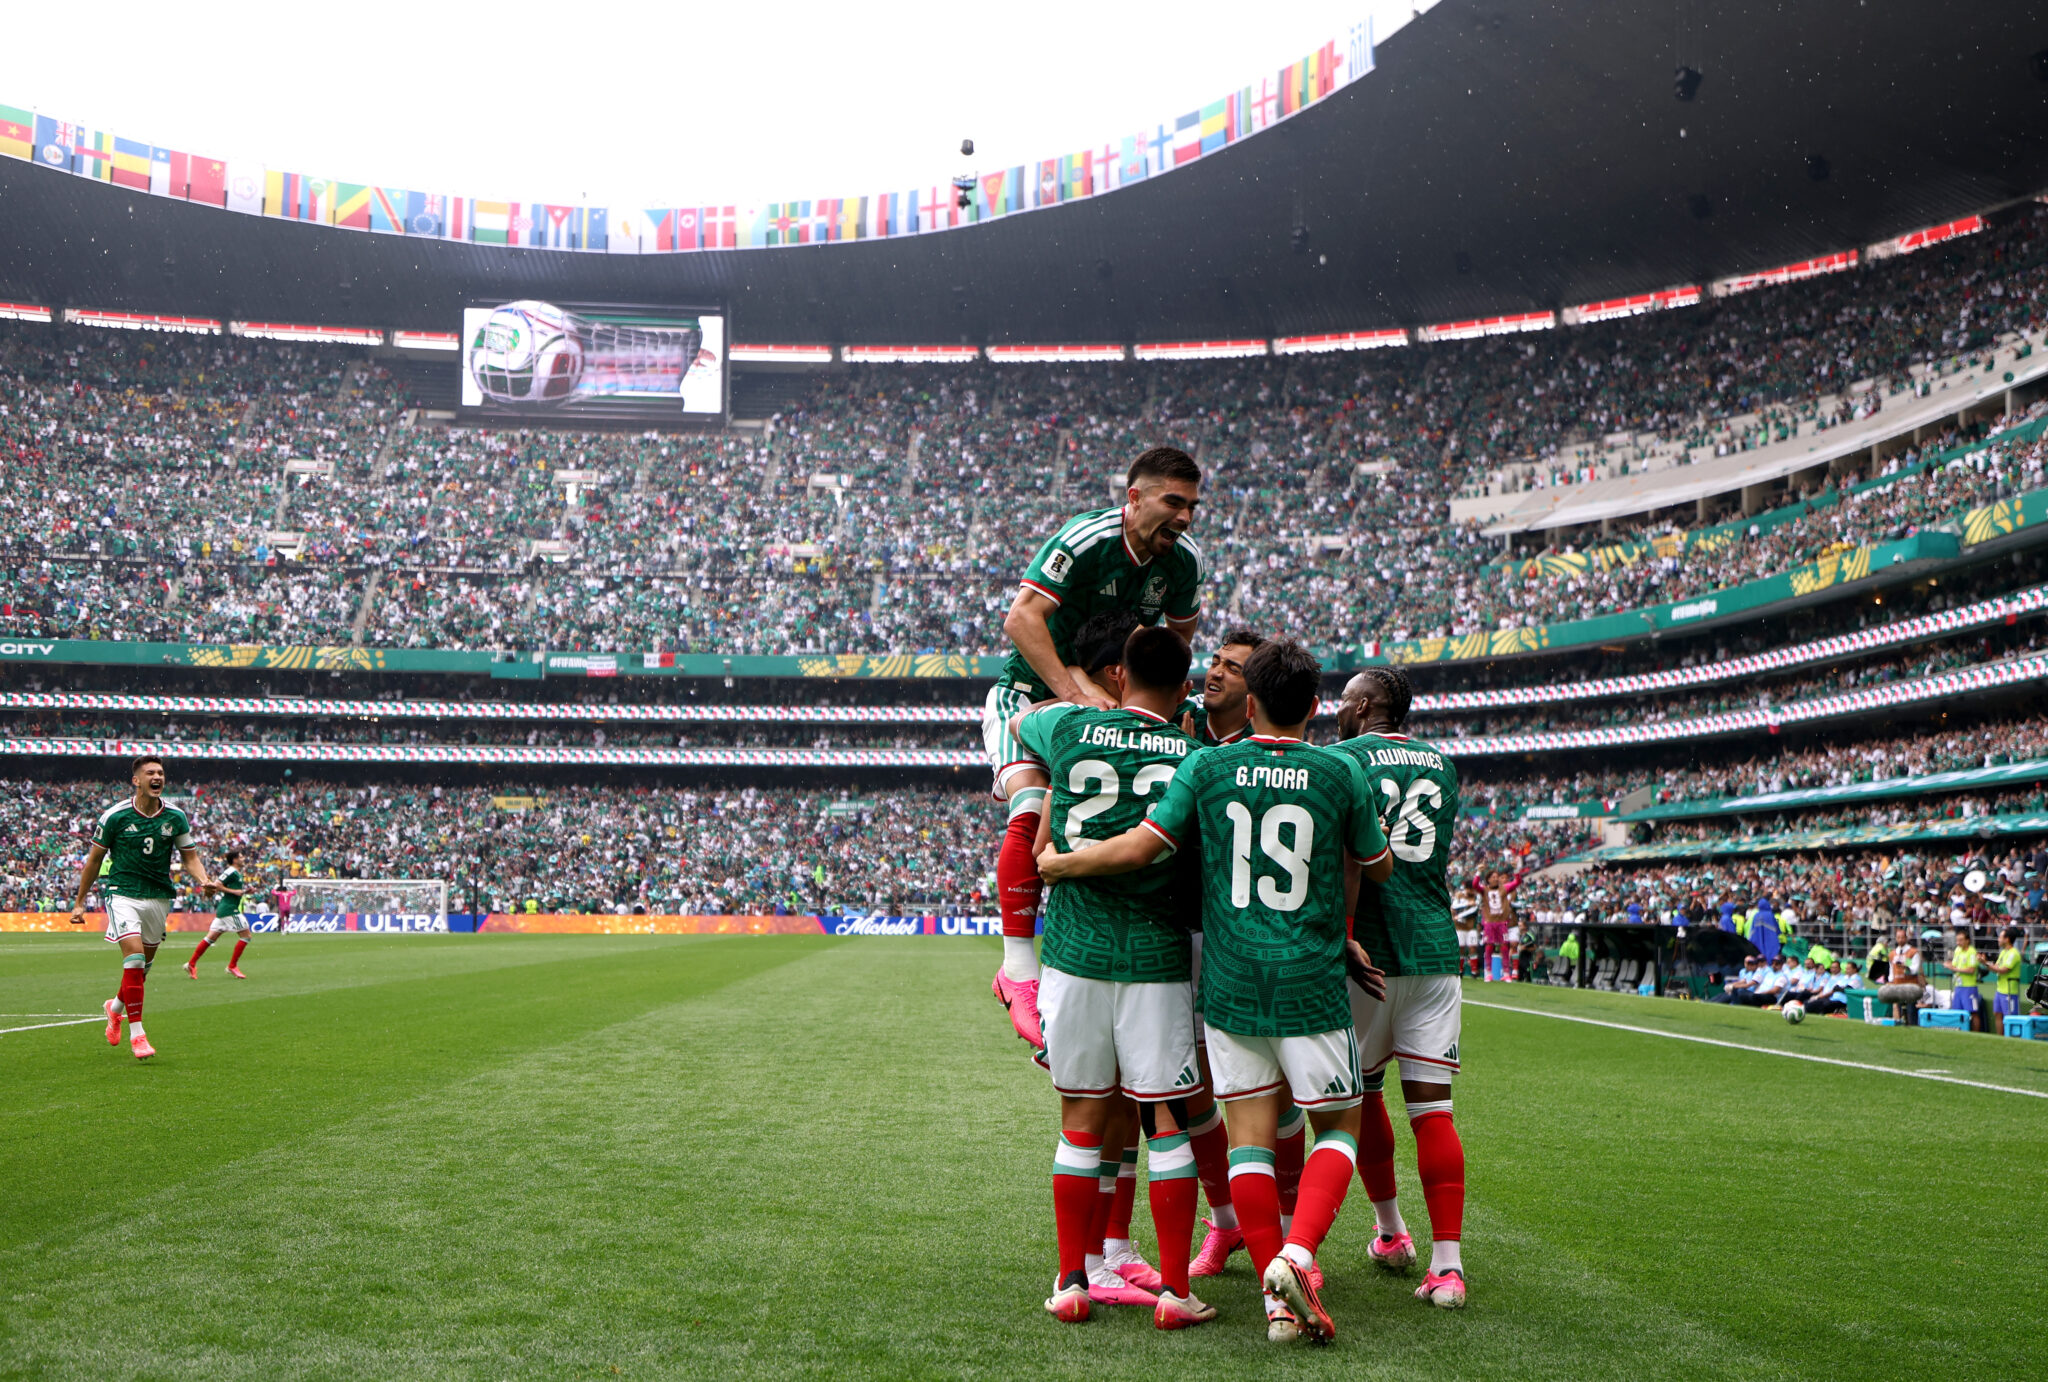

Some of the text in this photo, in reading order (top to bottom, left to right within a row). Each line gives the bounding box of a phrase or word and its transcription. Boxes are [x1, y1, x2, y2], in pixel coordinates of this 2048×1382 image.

[0, 642, 54, 655] CITY
[1078, 723, 1187, 757] J.GALLARDO
[1235, 765, 1309, 791] G.MORA
[142, 837, 154, 855] 3
[1226, 800, 1315, 912] 19
[365, 914, 449, 932] ULTRA
[835, 915, 1004, 936] Michelob ULTR
